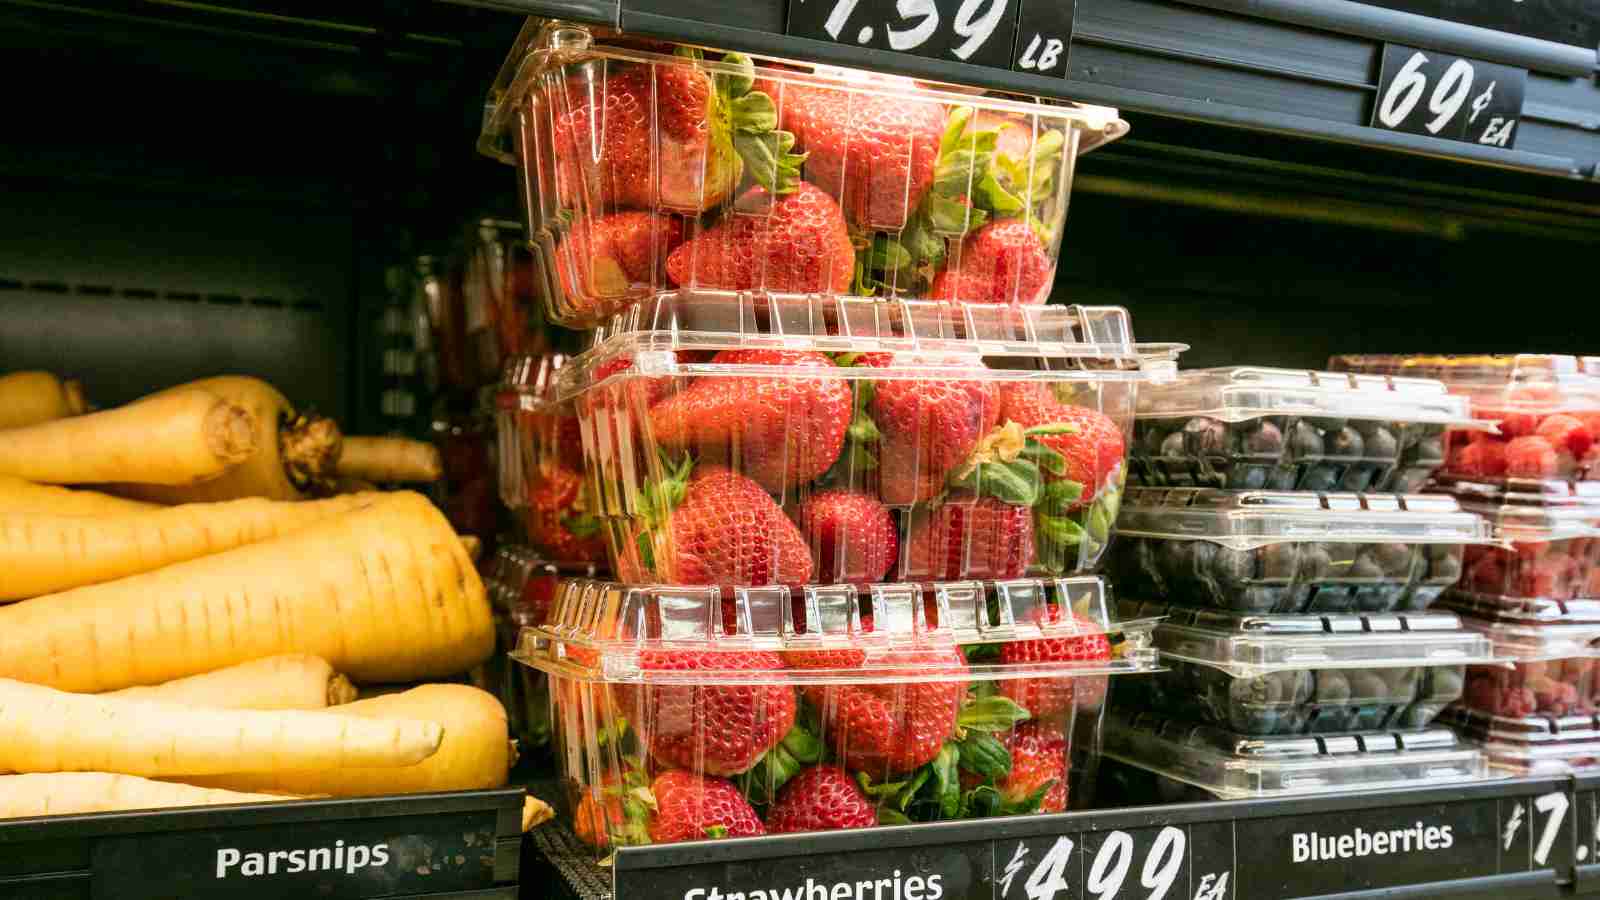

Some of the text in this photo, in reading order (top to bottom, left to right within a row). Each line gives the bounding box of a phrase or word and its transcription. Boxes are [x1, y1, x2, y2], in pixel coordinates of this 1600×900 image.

[1019, 33, 1063, 71] LB
[1479, 117, 1515, 146] EA
[1292, 821, 1453, 863] Blueberries
[1503, 792, 1600, 865] $7.
[216, 840, 390, 878] Parsnips
[1194, 871, 1229, 900] EA
